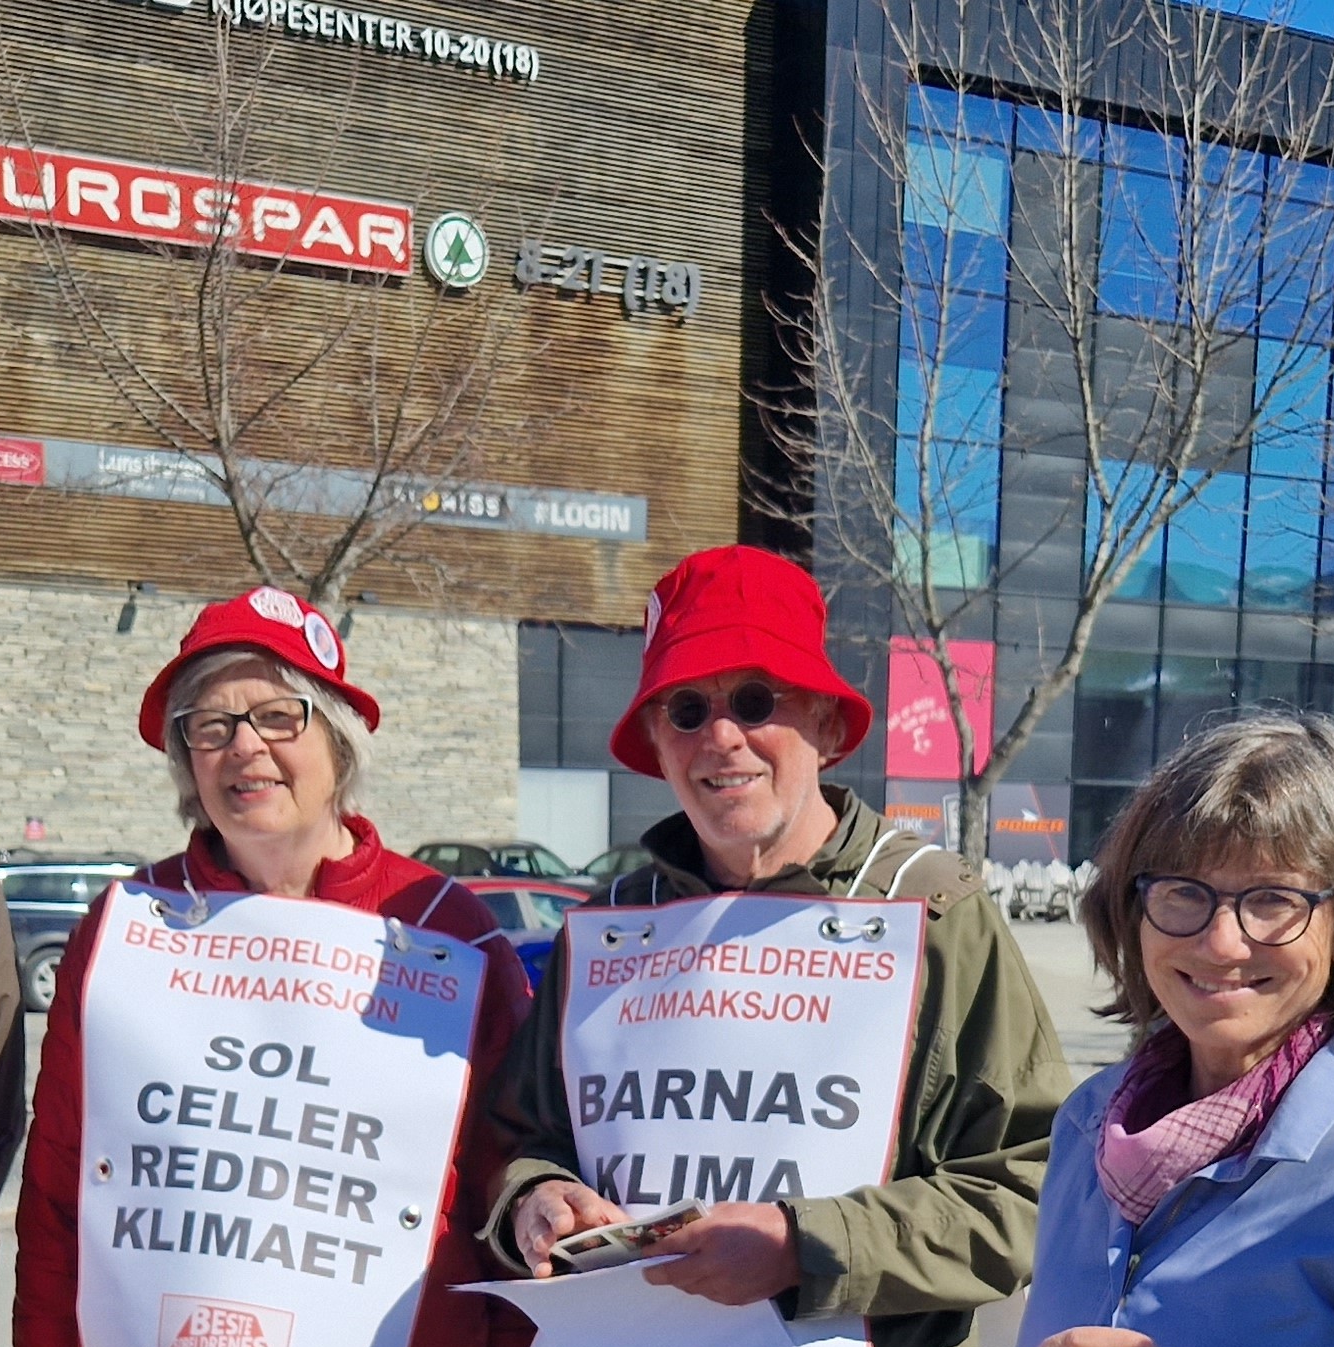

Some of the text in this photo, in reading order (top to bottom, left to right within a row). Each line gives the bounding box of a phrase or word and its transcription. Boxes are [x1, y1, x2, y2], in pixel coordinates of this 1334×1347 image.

[516, 239, 701, 318] 8-21 (18)
[534, 501, 631, 533] #LOGIN
[125, 922, 459, 1001] BESTEFORELDRENES
[588, 944, 896, 987] BESTEFORELDRENES
[169, 968, 400, 1024] KLIMAAKSJON
[618, 989, 832, 1025] KLIMAAKSJON
[204, 1036, 331, 1087] SOL
[137, 1081, 384, 1161] CELLER
[578, 1068, 861, 1130] BARNAS
[131, 1144, 377, 1225] REDDER
[595, 1153, 805, 1206] KLIMA
[112, 1206, 383, 1286] KLIMAET
[191, 1306, 253, 1336] BESTE
